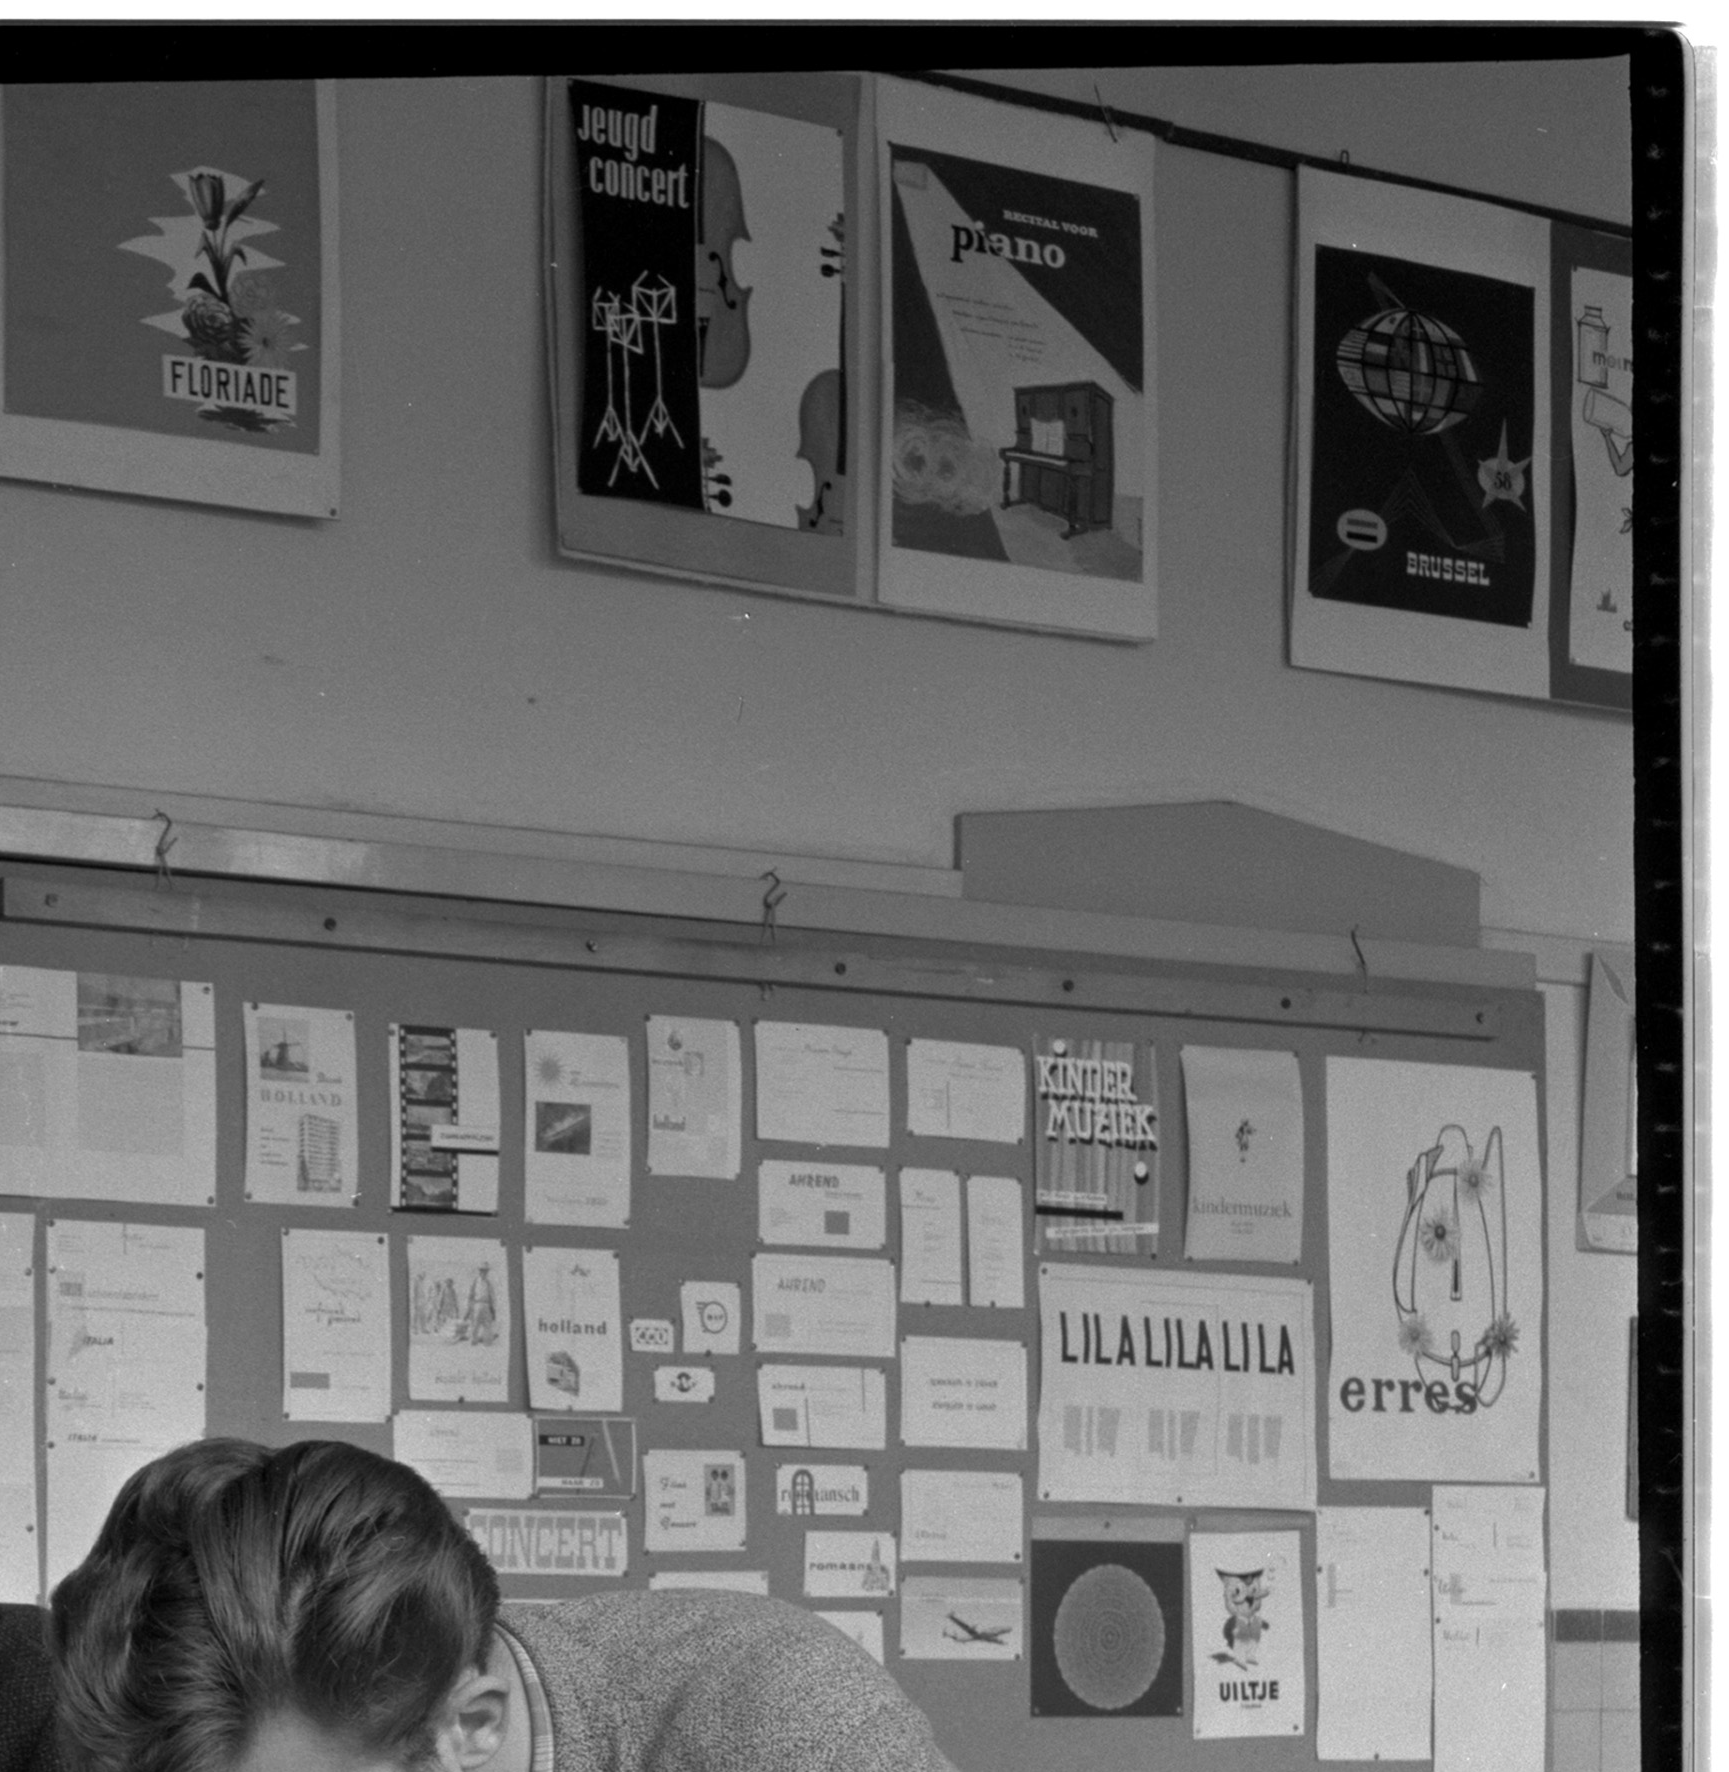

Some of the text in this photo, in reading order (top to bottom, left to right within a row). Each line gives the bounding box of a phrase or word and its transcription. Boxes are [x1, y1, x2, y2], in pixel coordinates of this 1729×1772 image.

[578, 103, 657, 162] jeugd
[589, 154, 690, 209] concert
[1002, 209, 1099, 239] RECITAL VOOR
[950, 220, 1066, 270] piano
[170, 360, 290, 409] FLORIADE
[1494, 470, 1512, 494] 58
[1406, 551, 1491, 586] BRUSSEL
[1036, 1056, 1137, 1102] KINDER
[260, 1089, 342, 1107] HOLLAND
[1045, 1101, 1157, 1145] MUZIEK
[789, 1174, 839, 1188] AHREND
[1192, 1197, 1293, 1218] kindermuziek
[777, 1278, 825, 1293] AHREND
[537, 1316, 607, 1335] holland
[1340, 1375, 1478, 1415] erres
[1219, 1680, 1279, 1702] UILTJE
